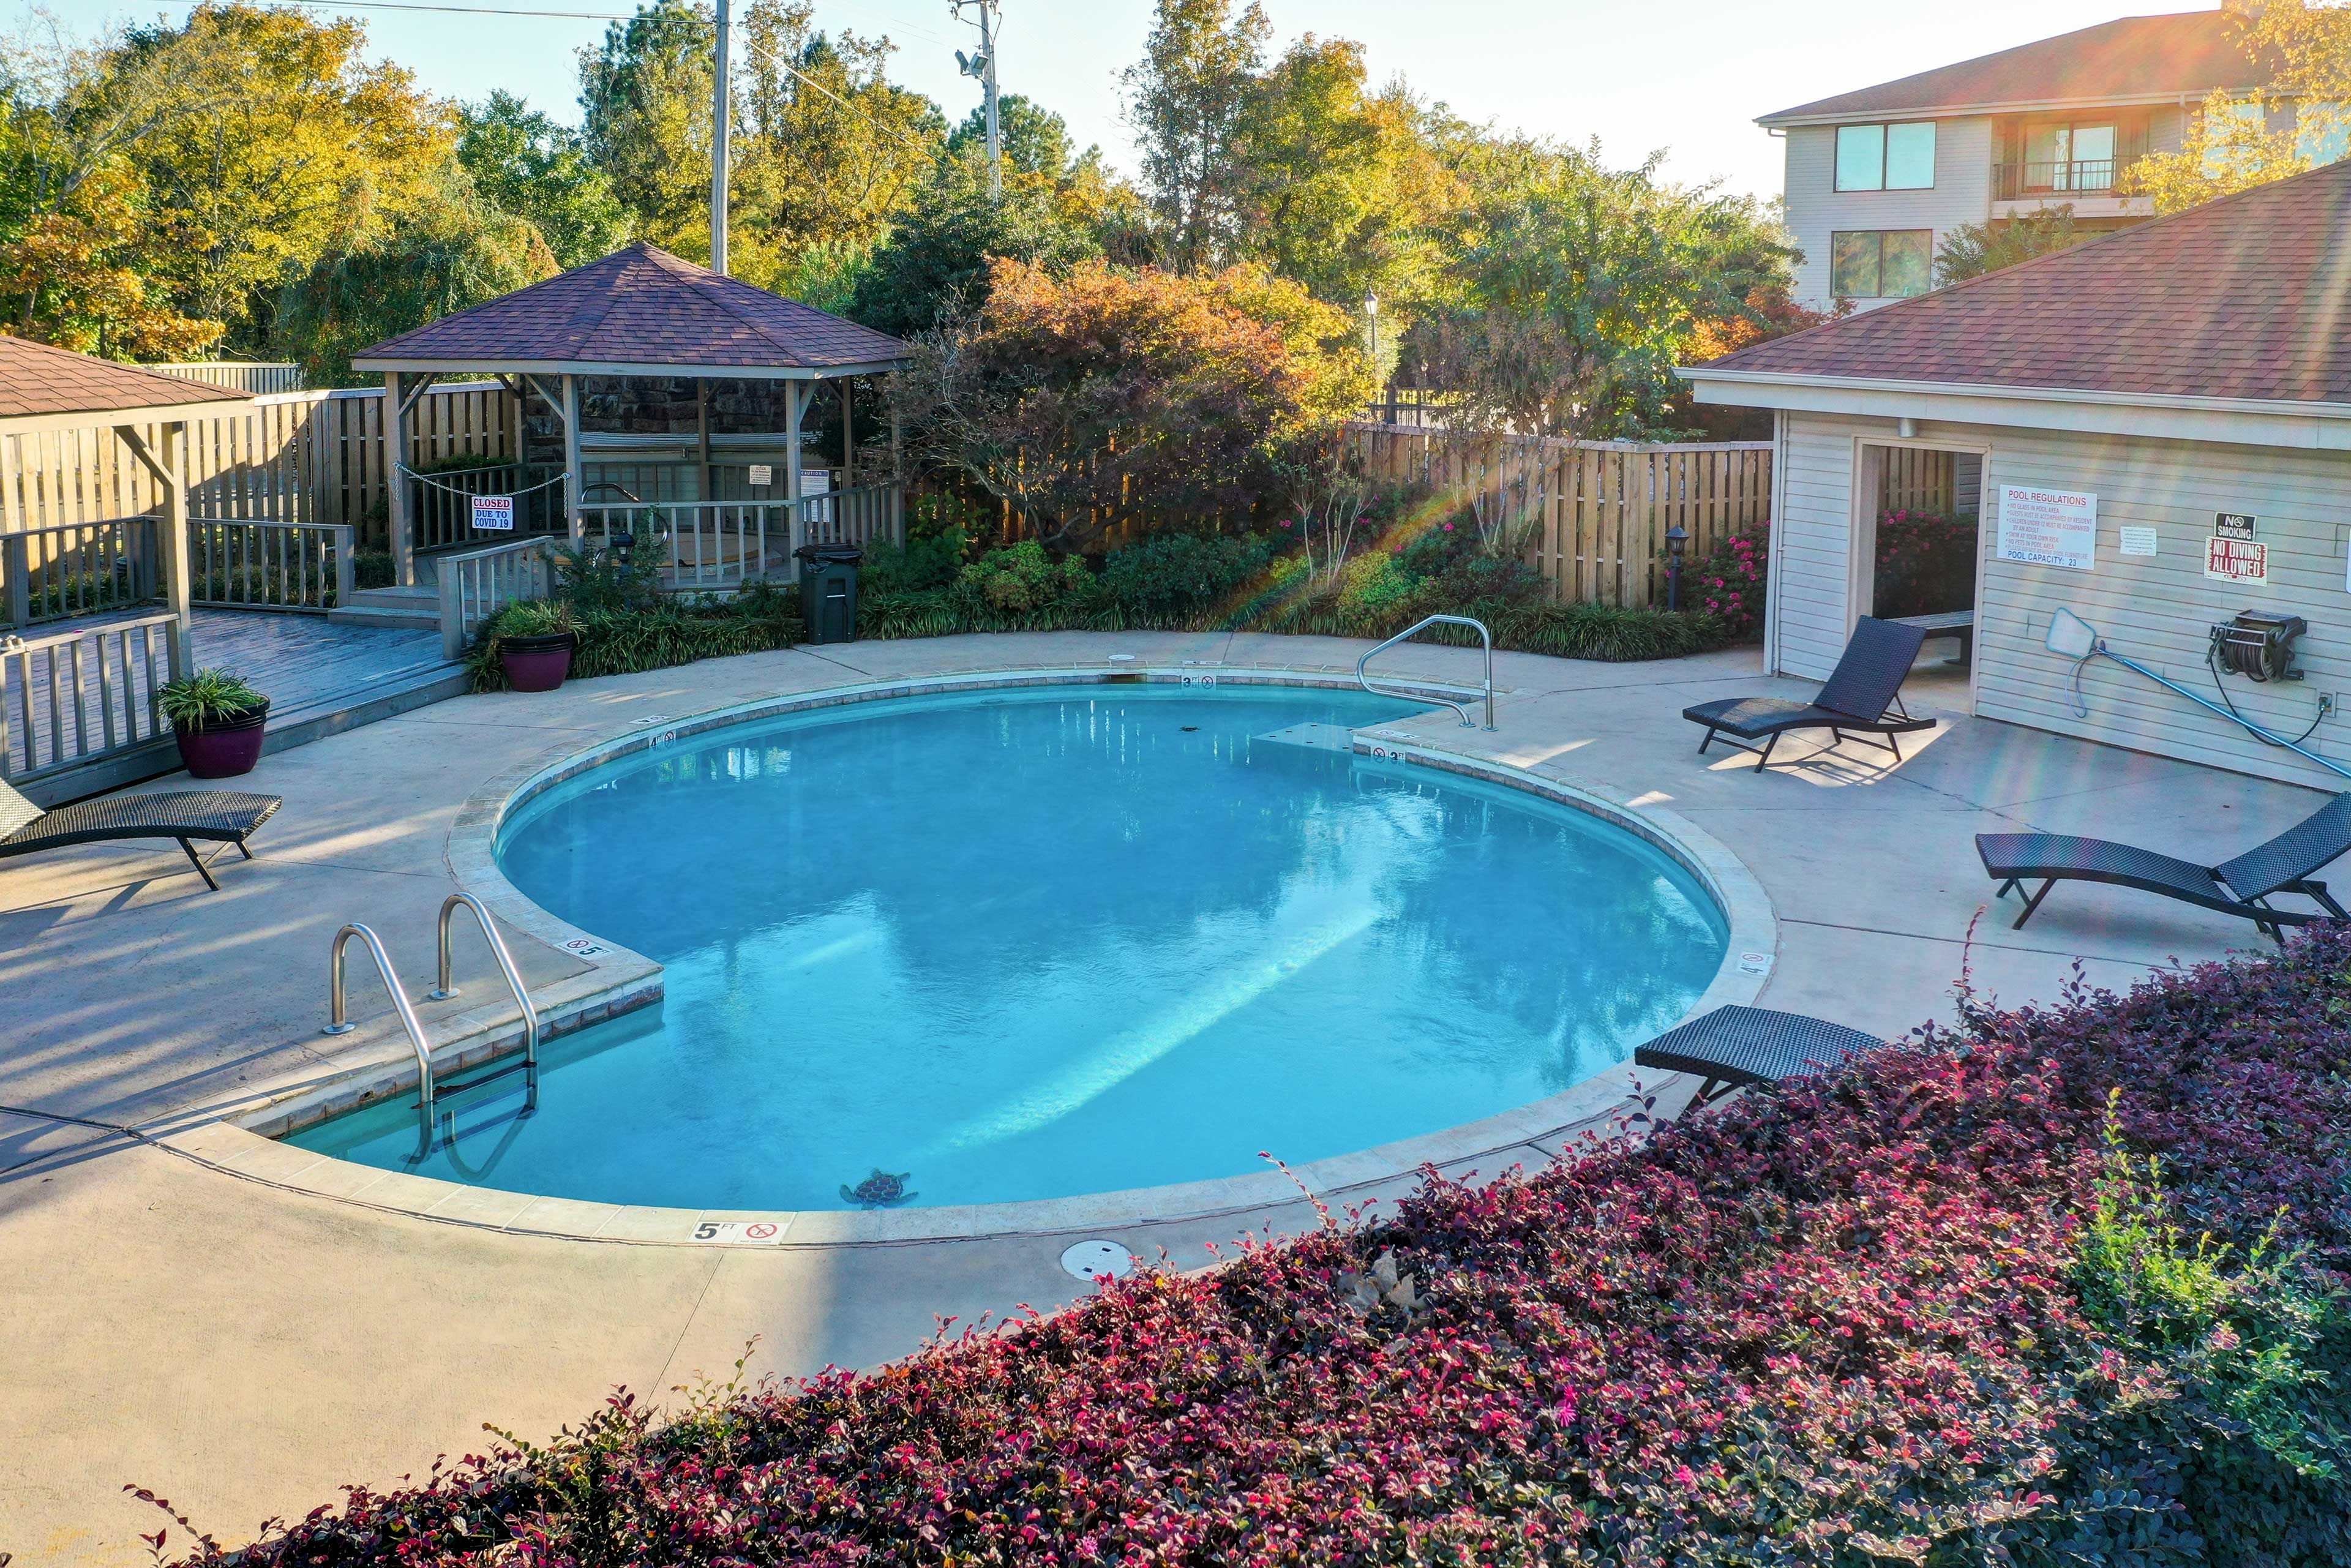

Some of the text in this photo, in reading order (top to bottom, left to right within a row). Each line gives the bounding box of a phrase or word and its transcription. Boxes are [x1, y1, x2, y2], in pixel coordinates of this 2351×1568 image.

[473, 498, 510, 508] CLOSED
[2009, 490, 2087, 506] POOL REGULATIONS
[475, 518, 509, 528] COVID 19
[2218, 526, 2251, 539] SMOKING
[2008, 550, 2026, 560] POOL
[2028, 553, 2064, 565] CAPACITY:
[2213, 540, 2262, 561] NO DIVING
[2213, 557, 2260, 577] ALLOWED
[579, 946, 603, 955] 5
[694, 1223, 721, 1240] 5
